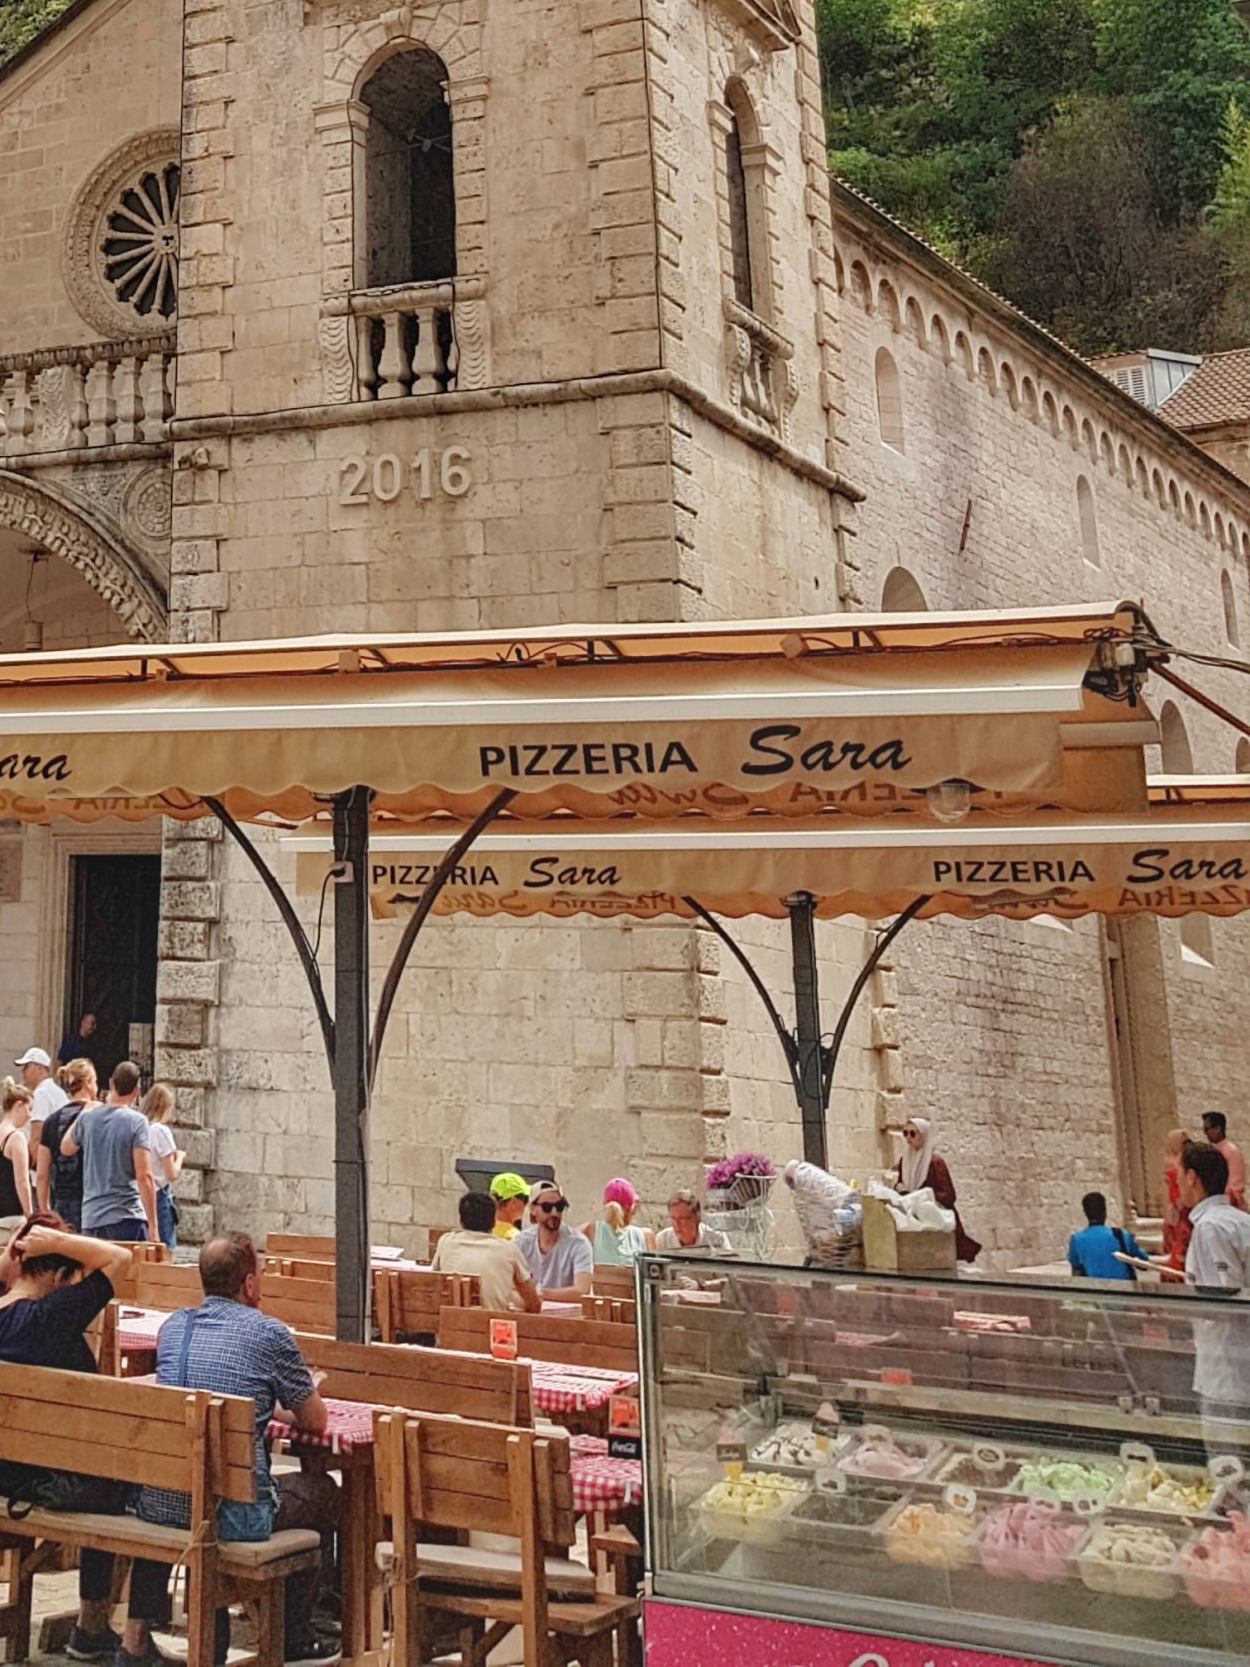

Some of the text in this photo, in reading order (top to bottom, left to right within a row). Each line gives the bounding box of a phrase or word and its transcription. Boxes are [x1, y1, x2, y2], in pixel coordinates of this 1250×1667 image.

[339, 445, 472, 506] 2016
[480, 724, 913, 777] PIZZERIA Sara
[372, 856, 622, 887] PIZZRIA Sara
[933, 848, 1248, 884] PIZZERIA Sara
